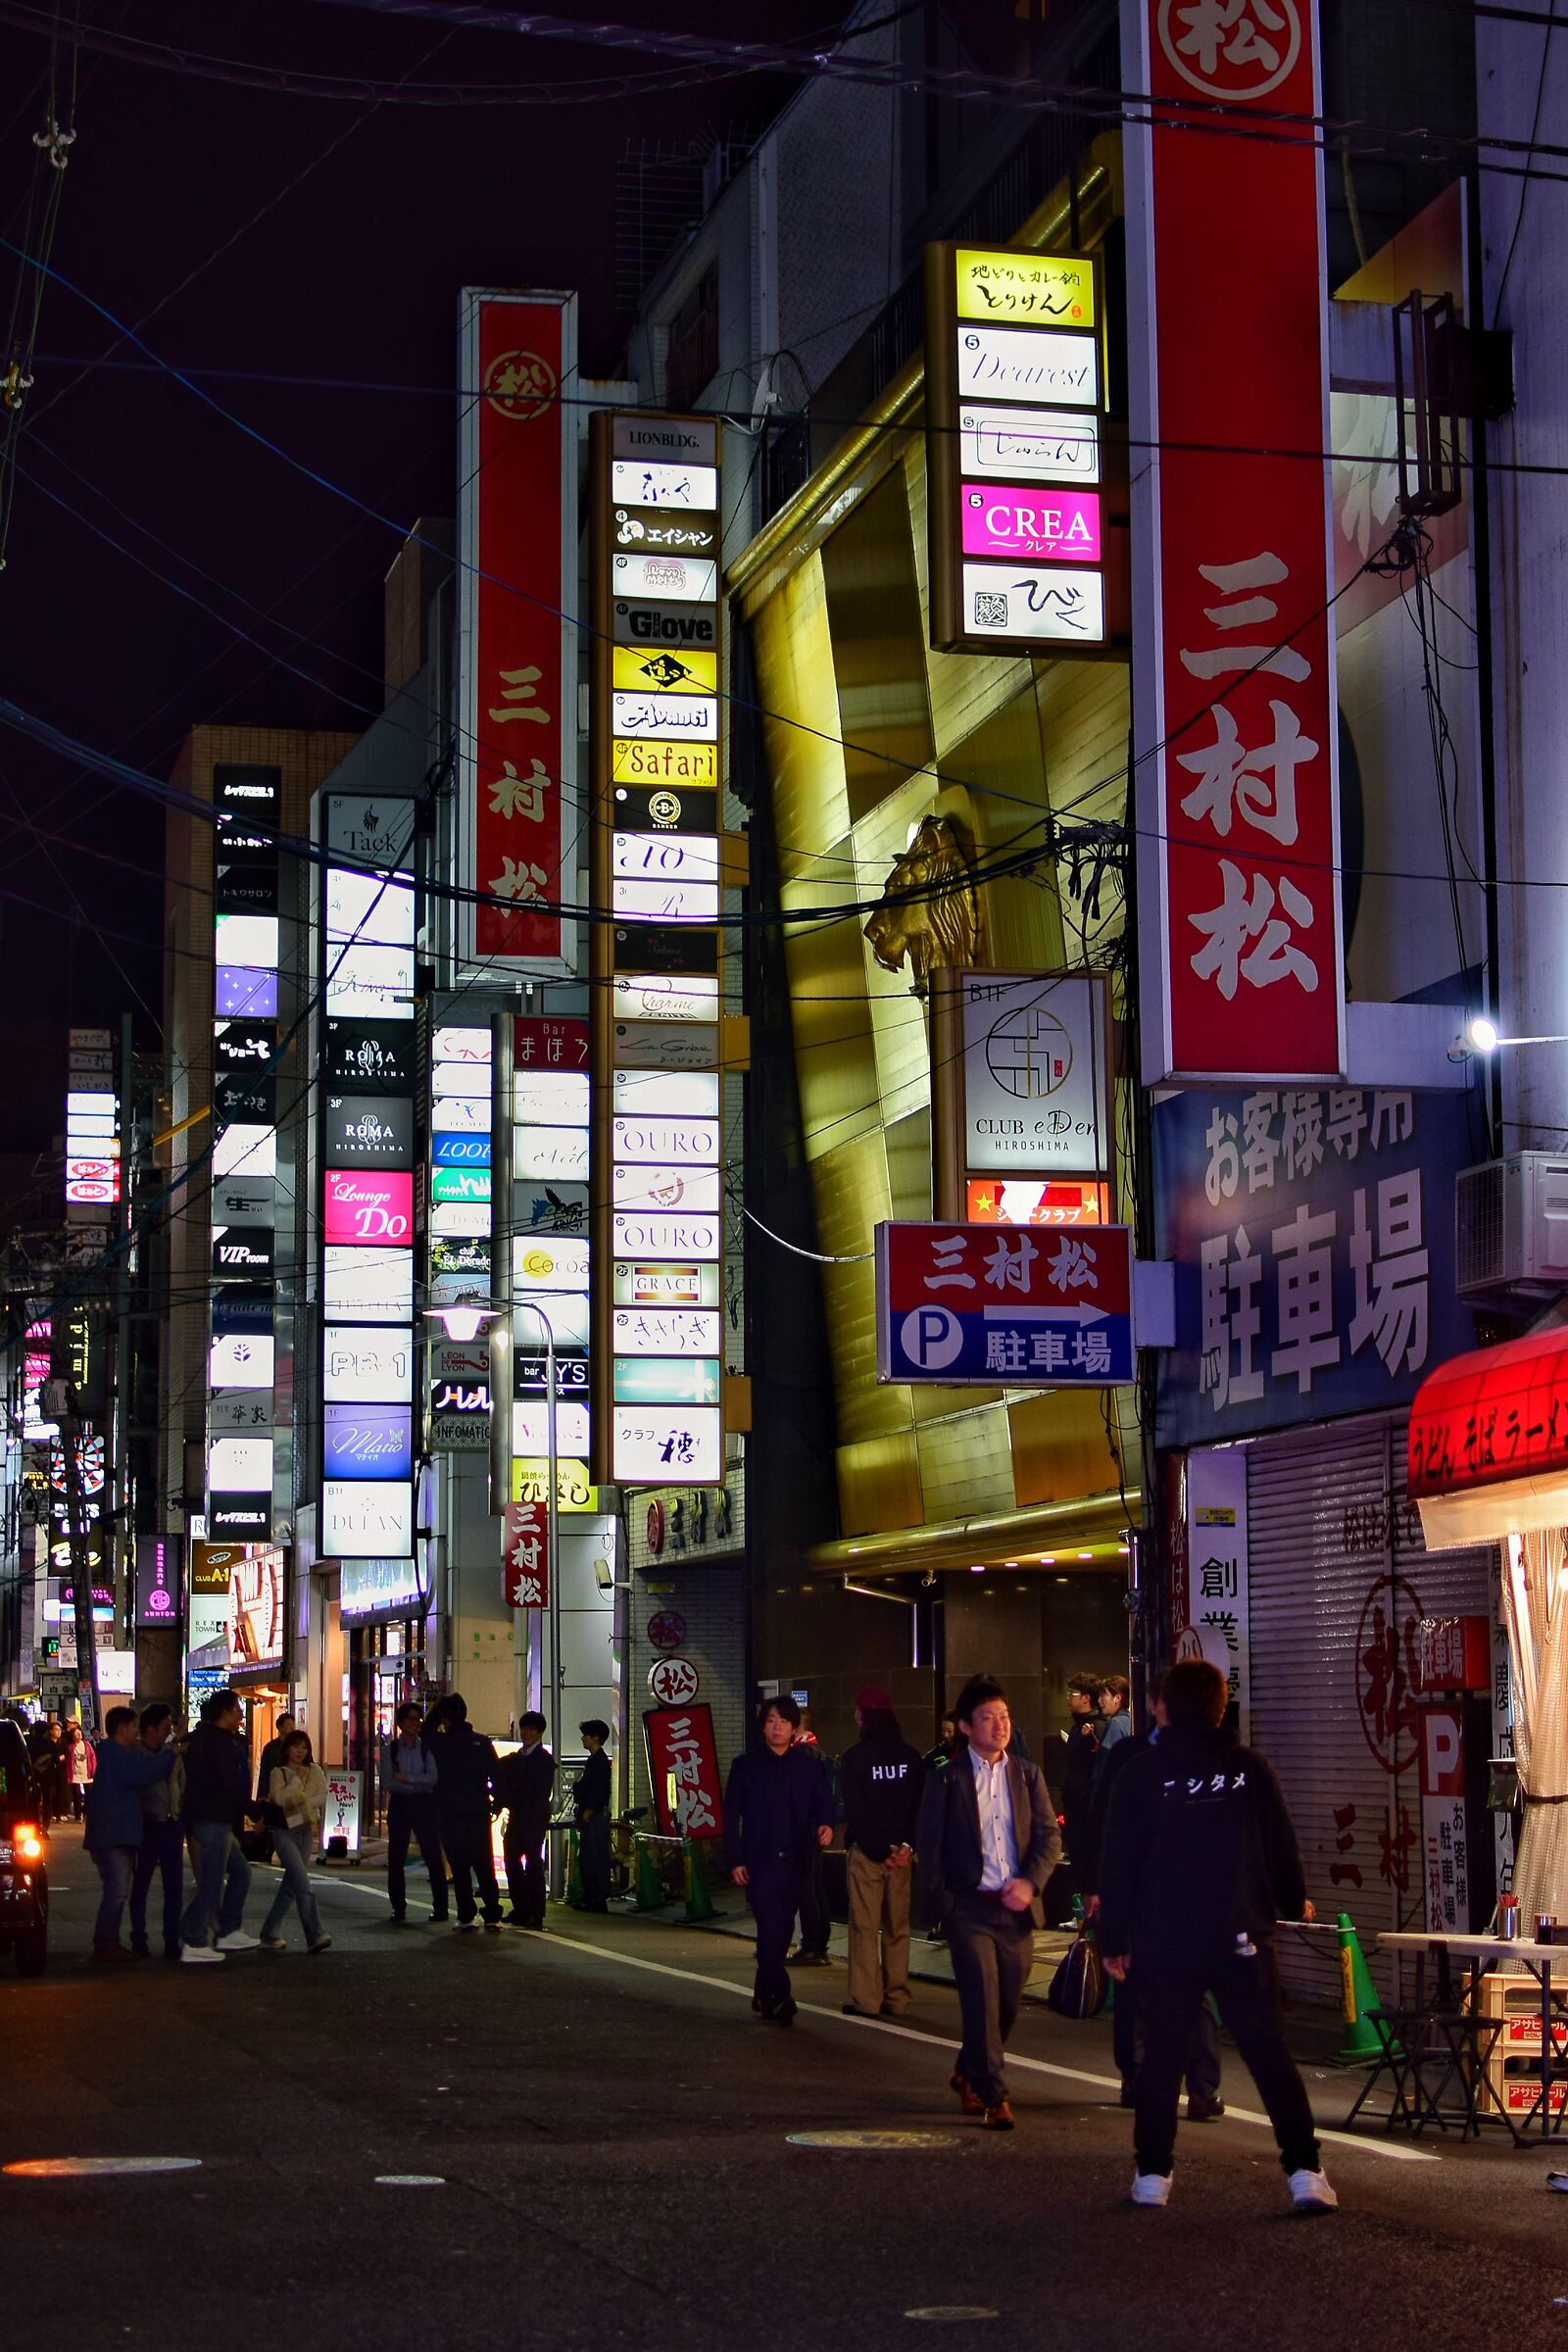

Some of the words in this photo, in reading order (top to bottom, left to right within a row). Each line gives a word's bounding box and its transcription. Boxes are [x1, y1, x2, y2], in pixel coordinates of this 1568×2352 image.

[1176, 0, 1286, 74] 松
[971, 265, 1080, 286] 地どりとカレー鍋
[977, 285, 1074, 315] とりけん
[986, 507, 1093, 541] CREA
[647, 528, 713, 547] エイシャン
[1025, 540, 1056, 553] クレア
[631, 745, 712, 777] Safari
[1177, 551, 1319, 1001] 三村松
[488, 665, 552, 918] 三村松
[343, 830, 397, 853] Tack
[544, 1023, 565, 1035] Bar
[345, 1049, 396, 1063] ROMA
[330, 1099, 343, 1108] 3F
[345, 1124, 394, 1138] ROMA
[976, 1118, 1023, 1135] CLUB
[623, 1131, 712, 1153] OURO
[995, 1141, 1069, 1152] HIROSHIMA
[331, 1182, 391, 1208] Lounge
[355, 1207, 408, 1238] Do
[624, 1227, 712, 1249] OURO
[220, 1246, 251, 1263] VIP
[924, 1233, 1099, 1293] 三村松
[637, 1277, 698, 1292] GRACE
[1200, 1168, 1429, 1412] 駐車場
[919, 1310, 950, 1365] P
[984, 1330, 1111, 1374] 駐車場
[524, 1367, 540, 1376] bar
[1464, 1407, 1498, 1474] そば
[1412, 1426, 1454, 1491] うどん
[511, 1503, 542, 1606] 三村松
[658, 1666, 696, 1700] 松
[1426, 1715, 1459, 1792] P
[666, 1717, 717, 1831] 三村松
[872, 1764, 908, 1780] HUF
[1427, 1837, 1443, 1933] 三村松
[1511, 2019, 1566, 2031] アサヒール
[1510, 2086, 1566, 2098] アサヒール
